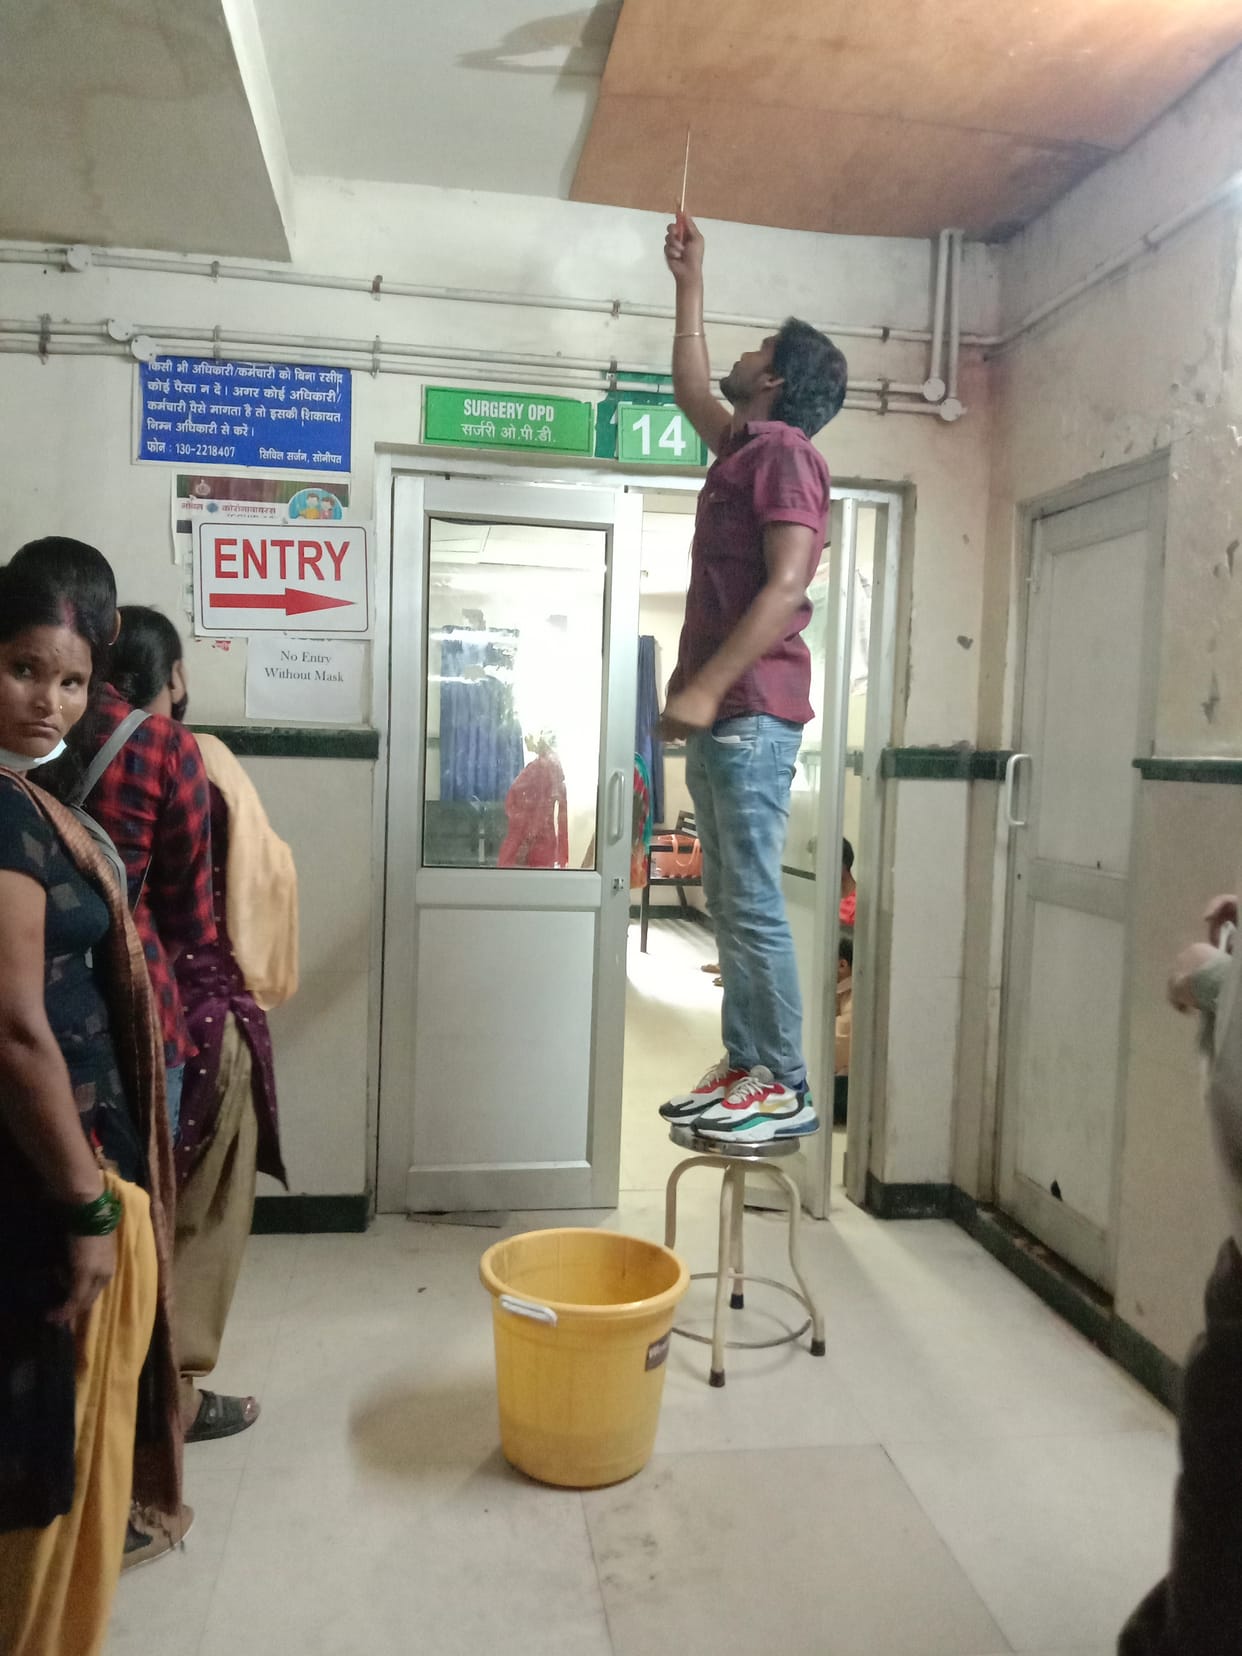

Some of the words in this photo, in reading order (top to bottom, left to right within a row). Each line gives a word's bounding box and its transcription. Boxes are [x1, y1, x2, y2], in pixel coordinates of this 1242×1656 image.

[176, 360, 188, 373] भी
[279, 366, 291, 380] को
[295, 367, 316, 382] बिना
[147, 378, 170, 395] कोई
[174, 379, 196, 394] पैसा
[200, 384, 210, 395] न
[232, 386, 260, 399] अगर
[263, 385, 286, 401] कोई
[147, 398, 186, 413] कर्मचारी
[189, 400, 206, 414] पैसे
[243, 403, 252, 418] है
[255, 404, 266, 418] तो
[269, 406, 297, 421] इसकी
[463, 398, 524, 419] SURGERY
[528, 403, 555, 422] OPD
[147, 417, 171, 432] निम्न
[176, 419, 217, 435] अधिकारी
[221, 422, 230, 436] से
[460, 420, 496, 438] सर्जरी
[632, 413, 687, 457] 14
[175, 443, 236, 457] 130-2218407
[259, 447, 284, 460] सिविल
[312, 450, 342, 464] सोनीपत
[214, 537, 351, 582] ENTRY
[281, 650, 298, 661] No
[302, 651, 332, 665] Entry
[264, 667, 311, 681] Without
[315, 670, 344, 682] Mask
